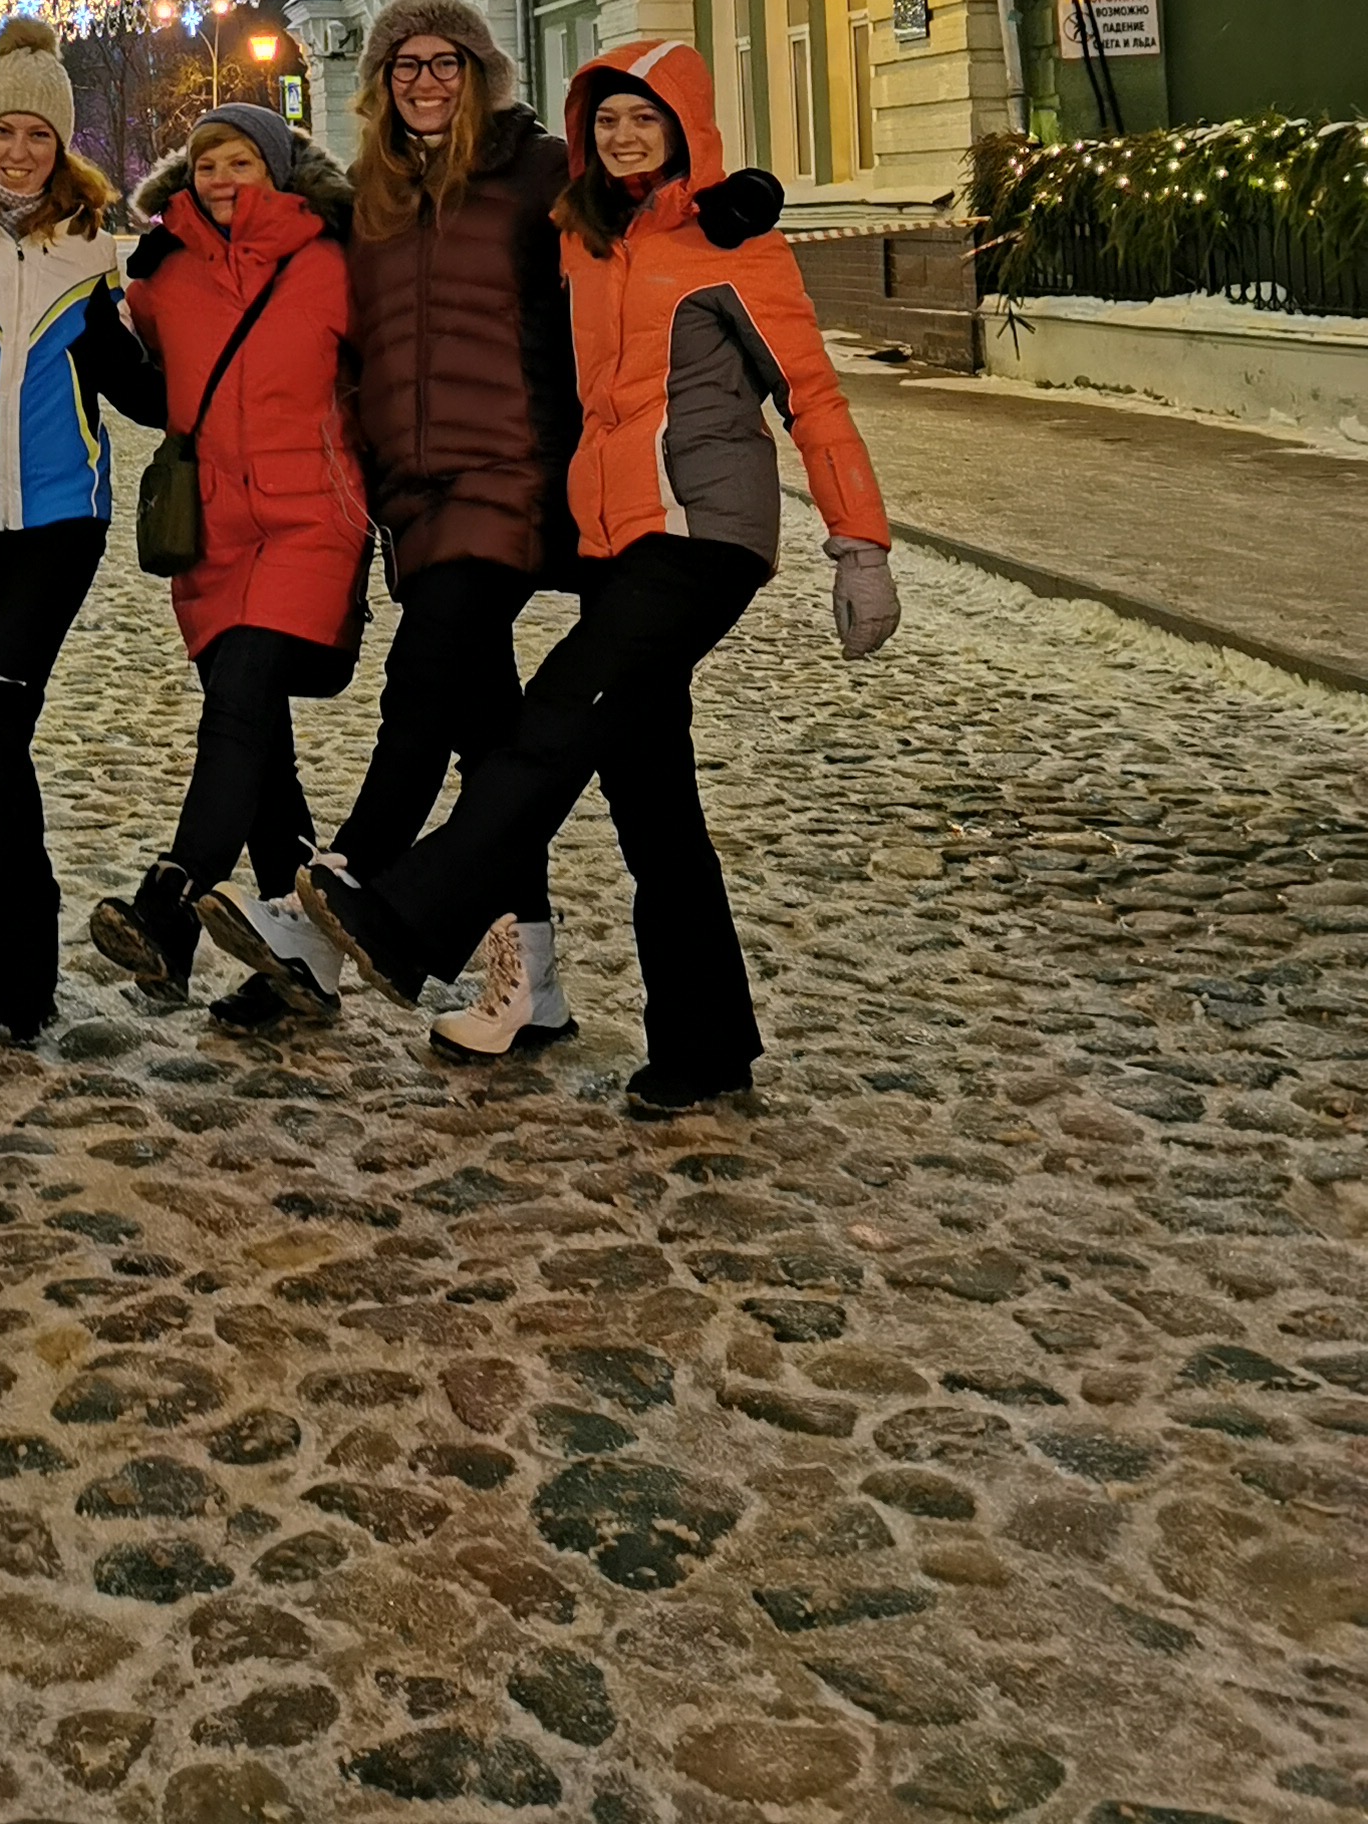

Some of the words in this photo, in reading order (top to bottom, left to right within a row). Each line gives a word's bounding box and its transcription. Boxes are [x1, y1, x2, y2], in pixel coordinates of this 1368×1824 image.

[1096, 5, 1149, 17] ВОЗМОЖНО
[1103, 21, 1145, 33] ПАДЕНИЕ
[1123, 38, 1130, 48] И
[1133, 36, 1157, 48] ЛЬДА
